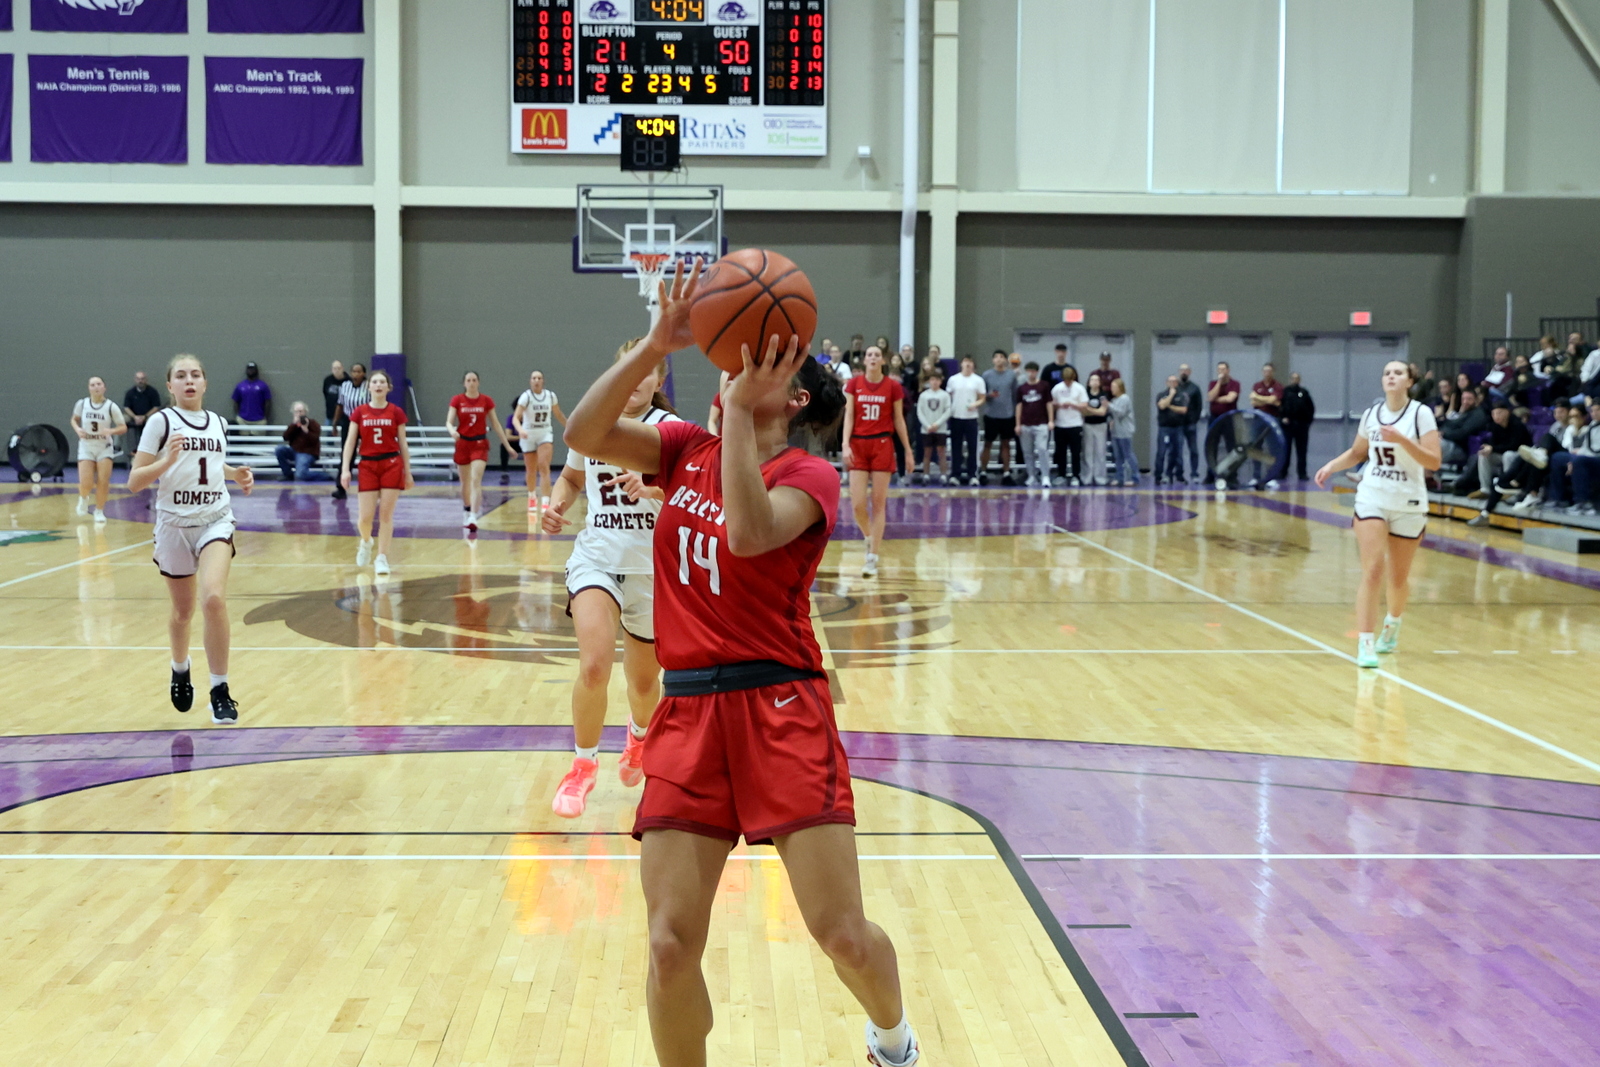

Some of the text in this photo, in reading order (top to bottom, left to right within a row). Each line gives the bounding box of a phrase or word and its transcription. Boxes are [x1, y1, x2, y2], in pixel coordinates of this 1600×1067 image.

[539, 11, 572, 24] 0 0
[652, 0, 702, 21] 4:04
[808, 14, 822, 28] 10
[539, 26, 572, 40] 0 0
[582, 25, 635, 38] BLUFFTON
[656, 32, 682, 40] PERIOD
[713, 27, 749, 38] GUEST
[790, 28, 822, 43] 0 0
[539, 42, 548, 56] 0
[562, 42, 572, 56] 2
[663, 44, 675, 60] 4
[720, 40, 749, 64] 50
[812, 45, 822, 59] 0
[538, 58, 548, 70] 4
[563, 57, 572, 71] 3
[586, 64, 610, 74] FOULS
[644, 65, 672, 74] PLAYER
[675, 66, 694, 74] FOUL
[728, 66, 752, 75] FOULS
[790, 60, 798, 74] 3
[808, 61, 822, 72] 14
[66, 67, 150, 80] Men's Tennis
[246, 69, 322, 82] Men's Track
[540, 73, 548, 87] 3
[36, 82, 58, 92] NAIA
[60, 83, 107, 94] Champions
[109, 84, 142, 93] (District
[214, 84, 234, 93] AMC
[236, 85, 286, 95] Champions:
[594, 73, 748, 93] 2 2 23 4 5 1
[790, 76, 798, 90] 2
[808, 76, 822, 90] 13
[636, 118, 675, 136] 4:04
[523, 138, 566, 146] Lewis Family
[688, 141, 746, 149] PARTNERS
[862, 404, 880, 420] 30
[91, 421, 98, 432] 3
[373, 428, 382, 444] 2
[182, 437, 222, 452] GENOA
[1374, 446, 1396, 466] 15
[198, 457, 208, 486] 1
[594, 512, 654, 530] COMETS
[678, 526, 721, 596] 14
